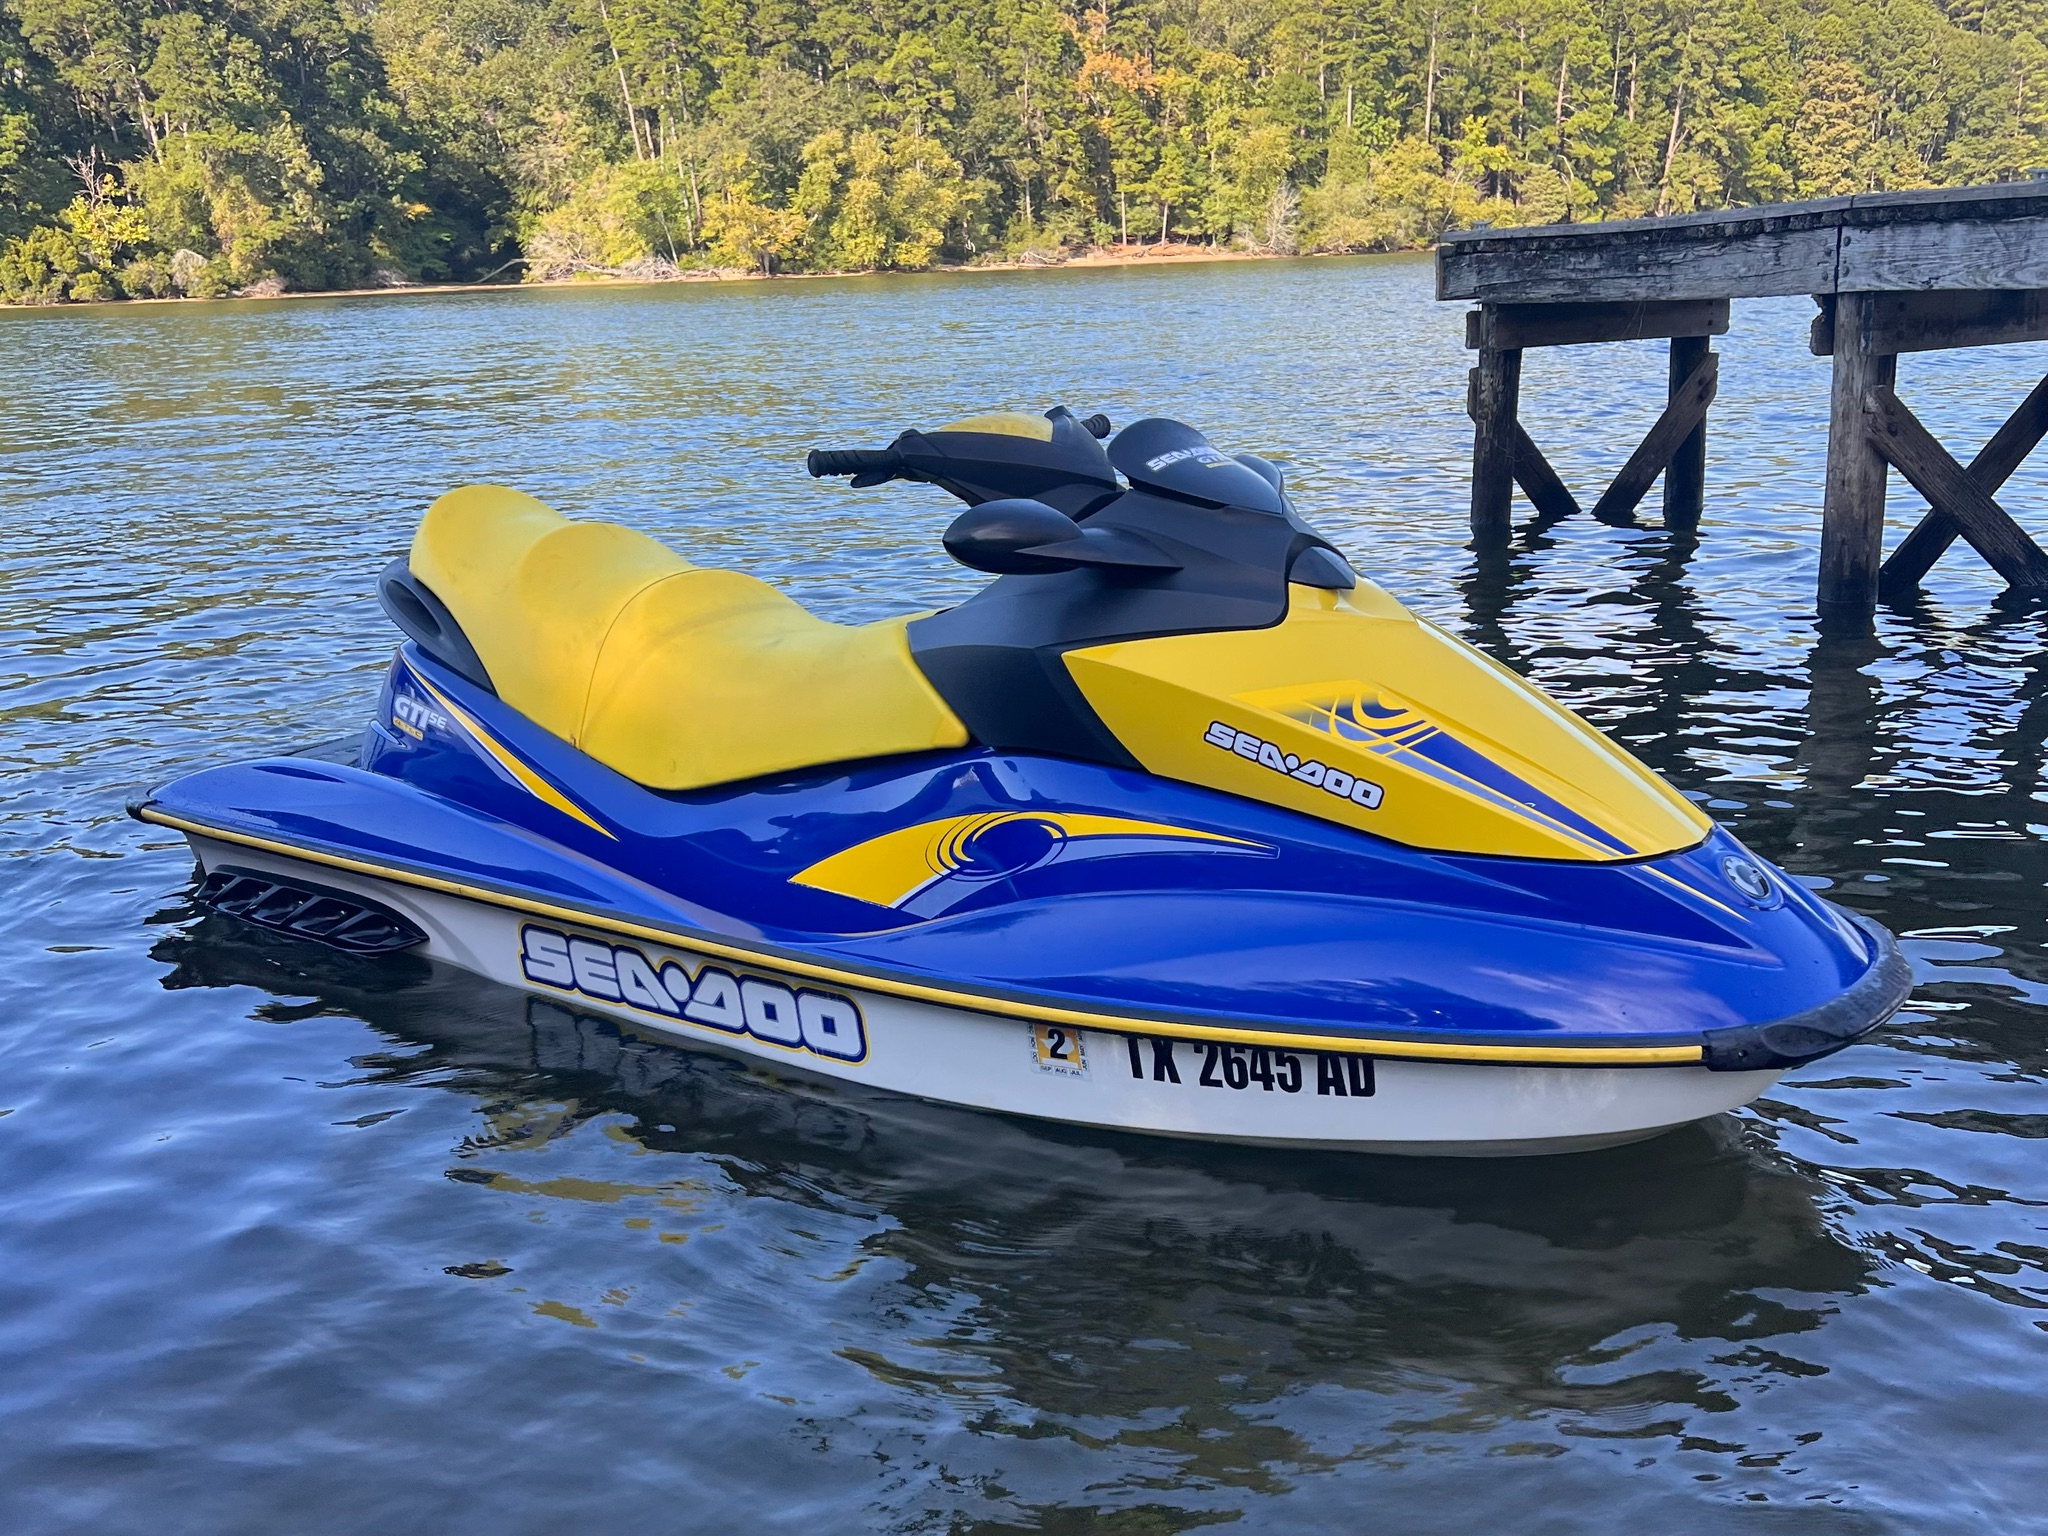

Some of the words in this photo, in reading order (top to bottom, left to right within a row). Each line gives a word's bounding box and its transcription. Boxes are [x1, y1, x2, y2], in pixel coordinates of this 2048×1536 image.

[395, 696, 431, 731] GTI
[1048, 1028, 1068, 1060] 2
[1194, 1044, 1303, 1094] 2645
[1317, 1053, 1376, 1098] AD
